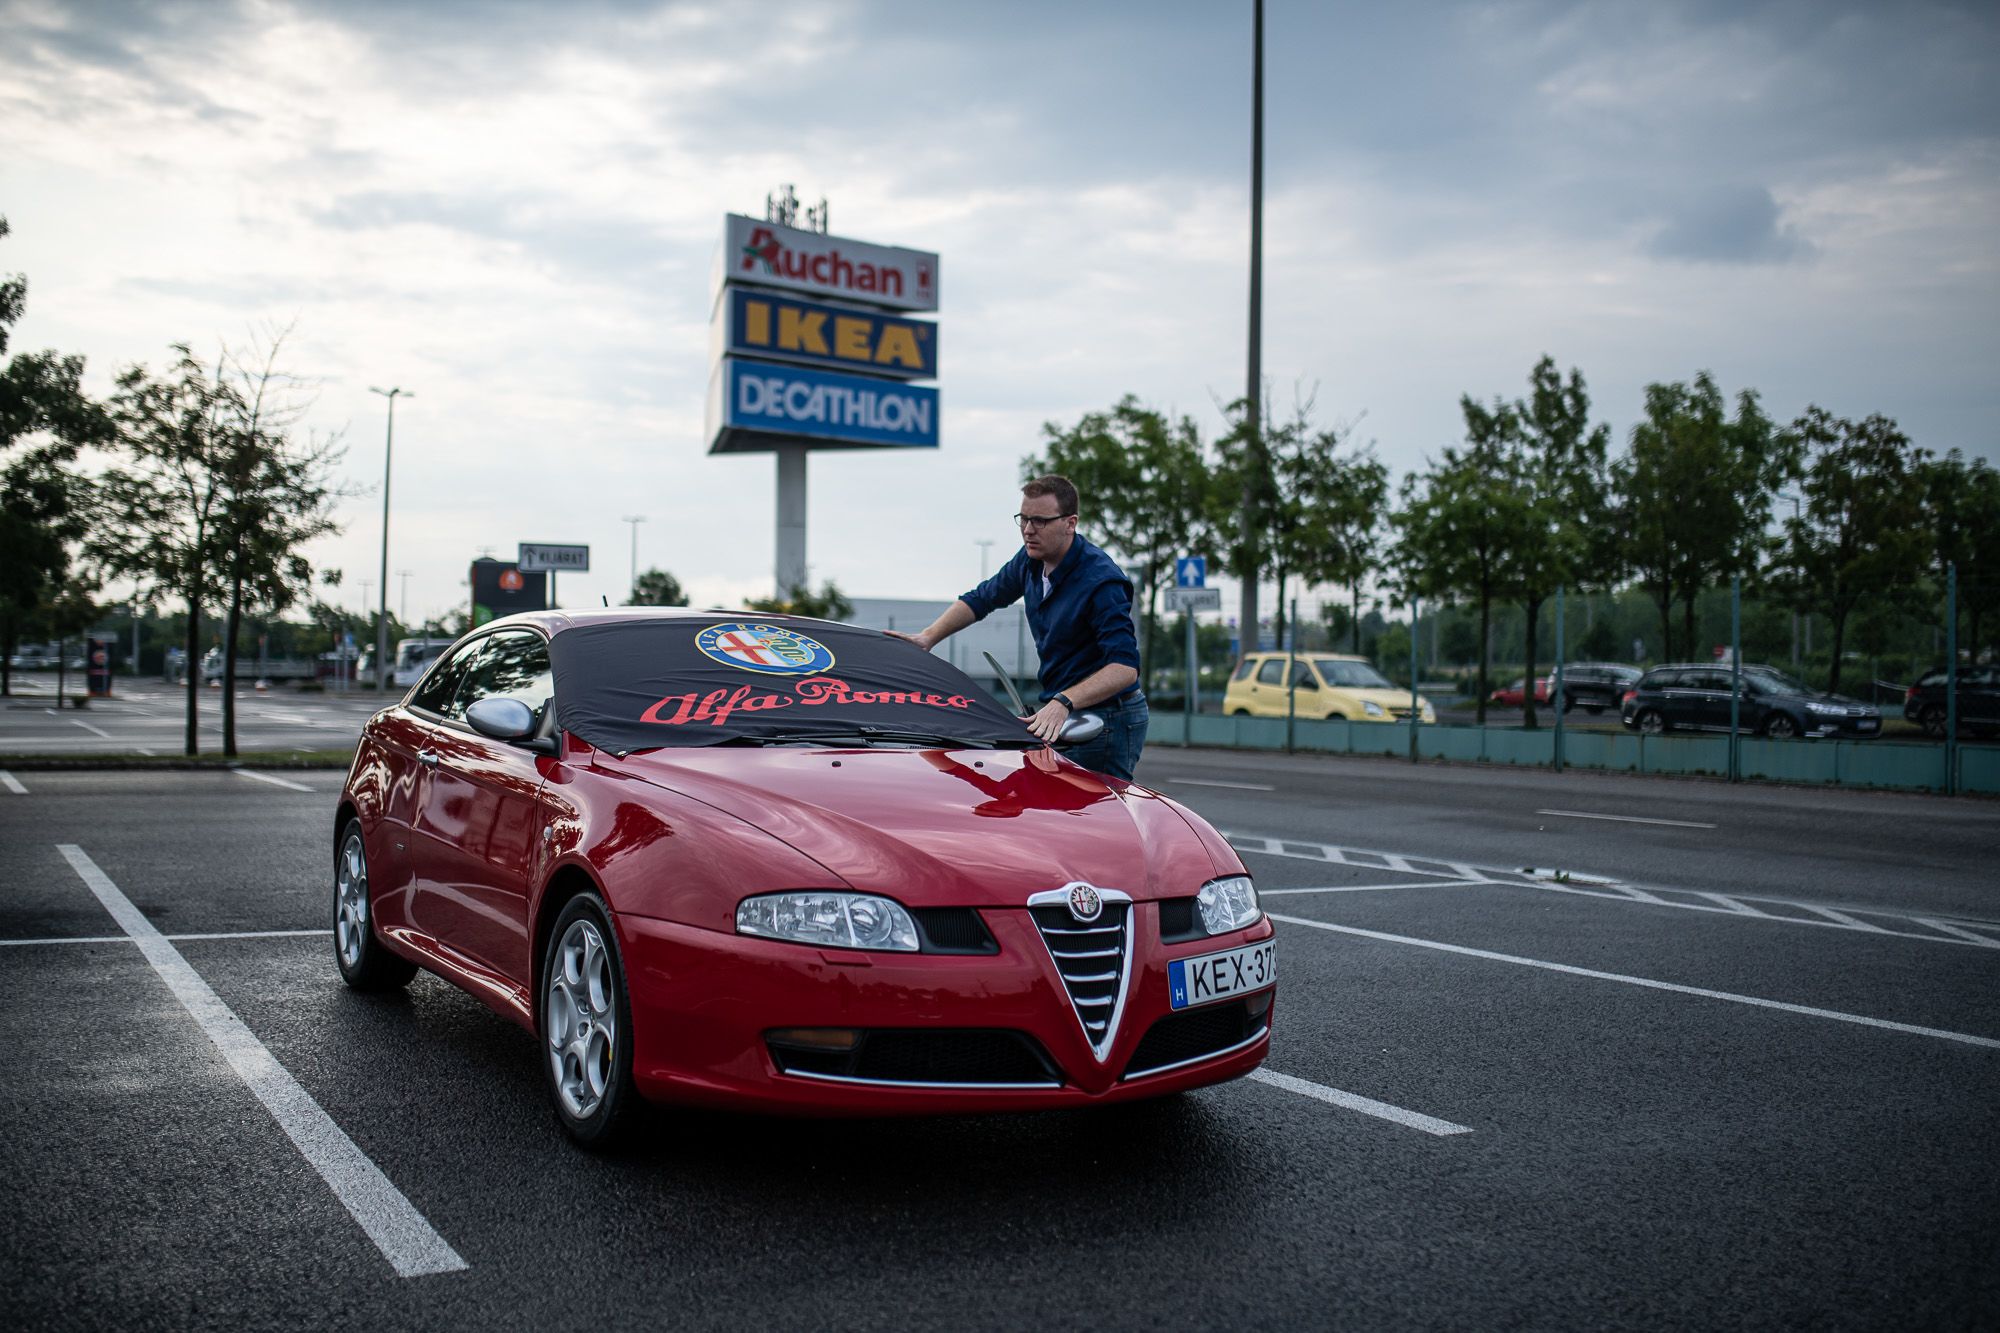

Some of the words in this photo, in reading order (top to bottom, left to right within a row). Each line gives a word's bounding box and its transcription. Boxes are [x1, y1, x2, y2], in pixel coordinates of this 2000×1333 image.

[741, 227, 904, 297] Auchan
[745, 300, 923, 369] IKEA
[738, 374, 930, 434] DECATHLON
[701, 629, 727, 652] ALFA
[735, 623, 821, 650] ROMEO
[639, 685, 793, 726] Alfa
[795, 676, 976, 709] Romeo
[1175, 987, 1184, 1001] H
